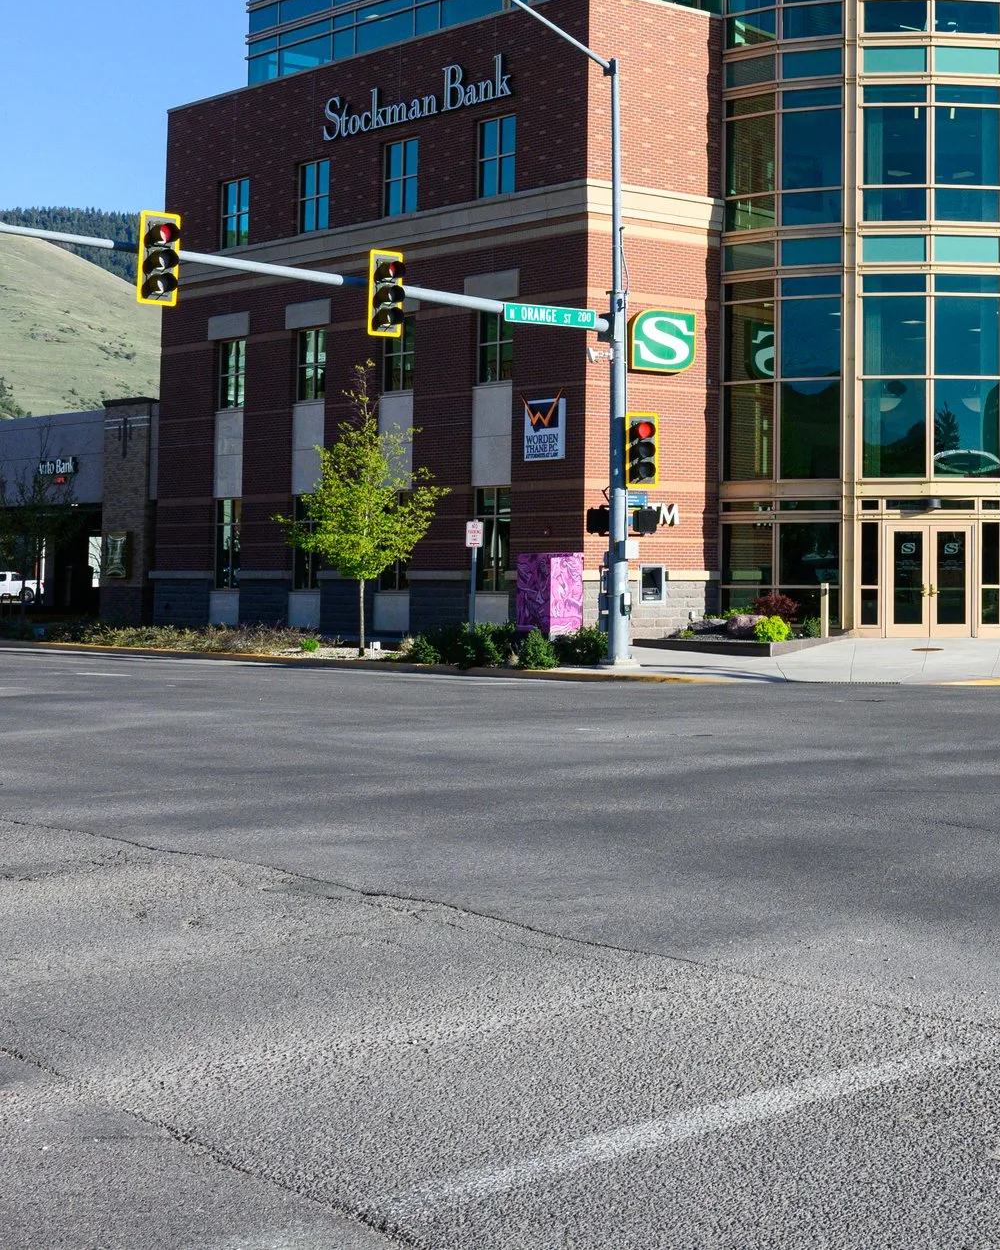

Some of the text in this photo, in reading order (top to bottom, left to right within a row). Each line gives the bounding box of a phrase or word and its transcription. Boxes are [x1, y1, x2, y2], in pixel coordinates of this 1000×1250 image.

[323, 53, 512, 141] Stockman Bank
[521, 306, 557, 323] ORANGE
[563, 313, 572, 324] ST
[577, 311, 592, 323] 200
[634, 316, 694, 365] S
[525, 433, 559, 445] WORDEN
[525, 444, 547, 453] THANE
[56, 456, 75, 474] Bank
